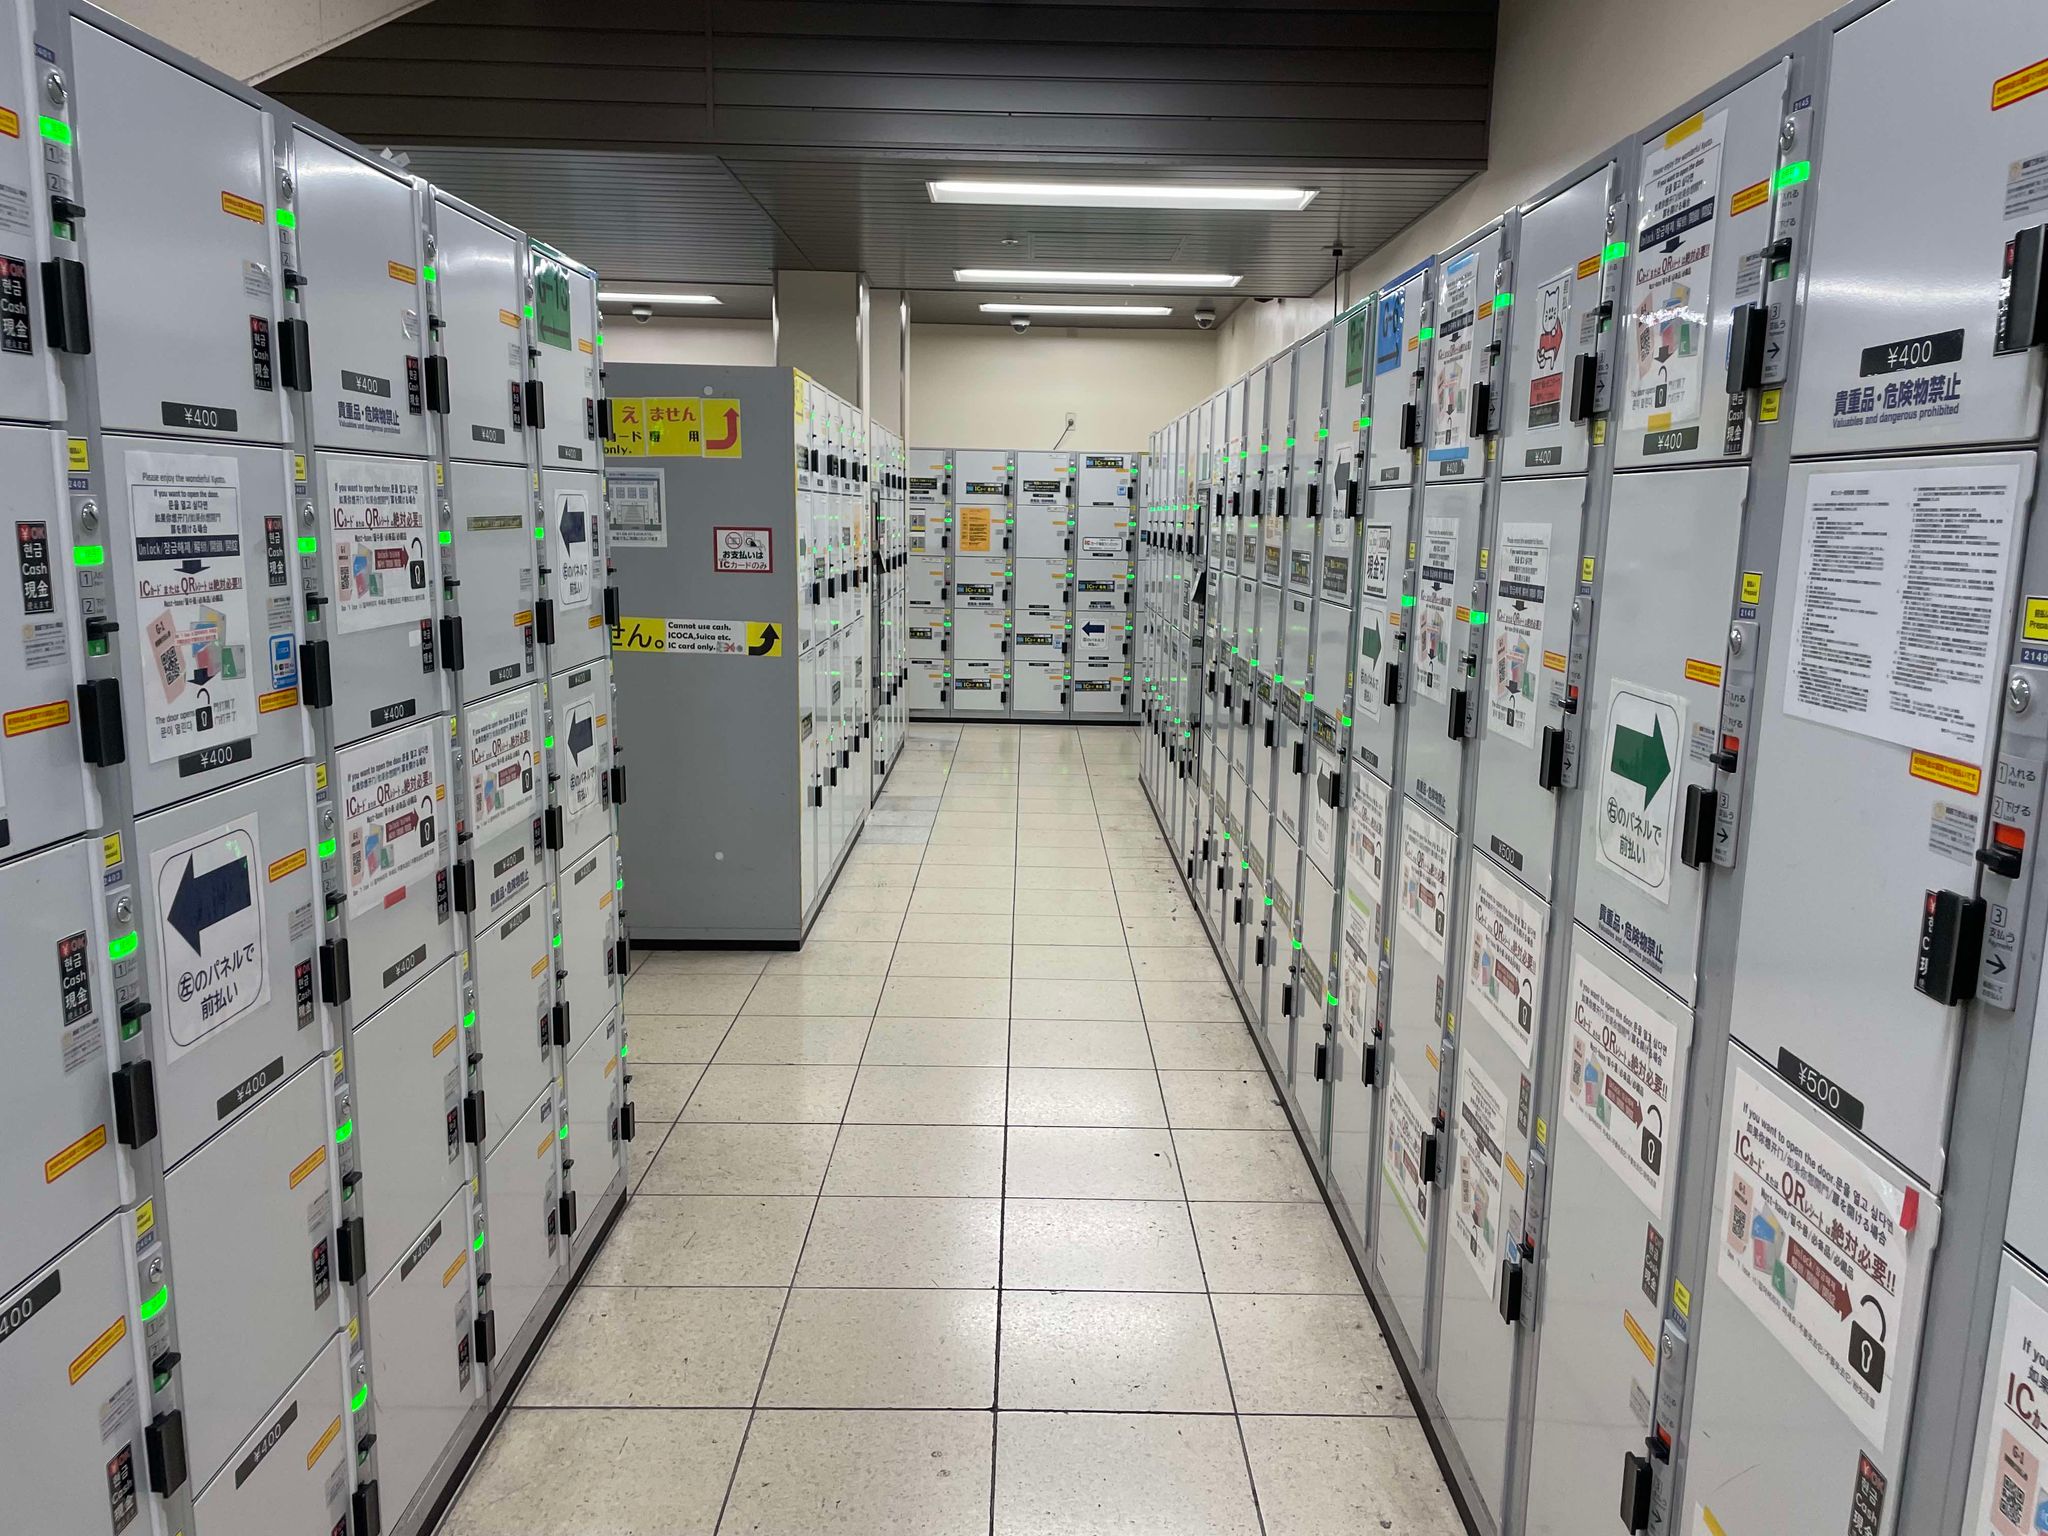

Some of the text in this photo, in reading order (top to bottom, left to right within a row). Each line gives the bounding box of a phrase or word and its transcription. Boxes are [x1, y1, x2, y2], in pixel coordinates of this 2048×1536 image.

[1, 298, 28, 315] Cash
[2, 318, 29, 338] 現金
[253, 348, 269, 361] Cash
[1887, 340, 1932, 368] ¥400
[355, 375, 379, 394] ¥400
[1834, 372, 1962, 416] 貴重品・危険物禁止
[184, 406, 218, 428] ¥400
[1728, 410, 1744, 421] Cash
[1833, 403, 1960, 428] Valuables and dangerous prohibited
[1657, 432, 1683, 450] ¥400
[1727, 425, 1742, 442] 現金
[1535, 450, 1552, 464] ¥400
[268, 548, 283, 557] Cash
[722, 550, 764, 560] お支払いは
[22, 563, 48, 576] Cash
[719, 561, 768, 570] ICカードのみ
[24, 580, 49, 599] 現金
[668, 622, 696, 630] Cannot
[712, 623, 731, 631] cash.
[668, 641, 716, 651] IC card only.
[383, 705, 405, 722] ¥400
[200, 746, 233, 769] ¥400
[2008, 766, 2036, 782] 入れる
[2005, 801, 2032, 817] 下げる
[1619, 834, 1646, 864] 前払い
[1994, 909, 2003, 923] 3
[1989, 926, 2015, 944] 支払う
[394, 955, 415, 976] ¥400
[63, 970, 87, 989] Cash
[65, 986, 88, 1010] 現金
[201, 982, 239, 1021] 前払い
[236, 1071, 267, 1104] ¥400
[1799, 1063, 1841, 1109] ¥500
[1748, 1107, 1760, 1124] you
[1761, 1117, 1777, 1138] want
[1778, 1129, 1785, 1144] to
[1786, 1138, 1803, 1159] open
[1805, 1149, 1816, 1168] the
[2022, 1336, 2032, 1354] If
[253, 1423, 283, 1464] ¥400
[1855, 1492, 1877, 1527] Cash
